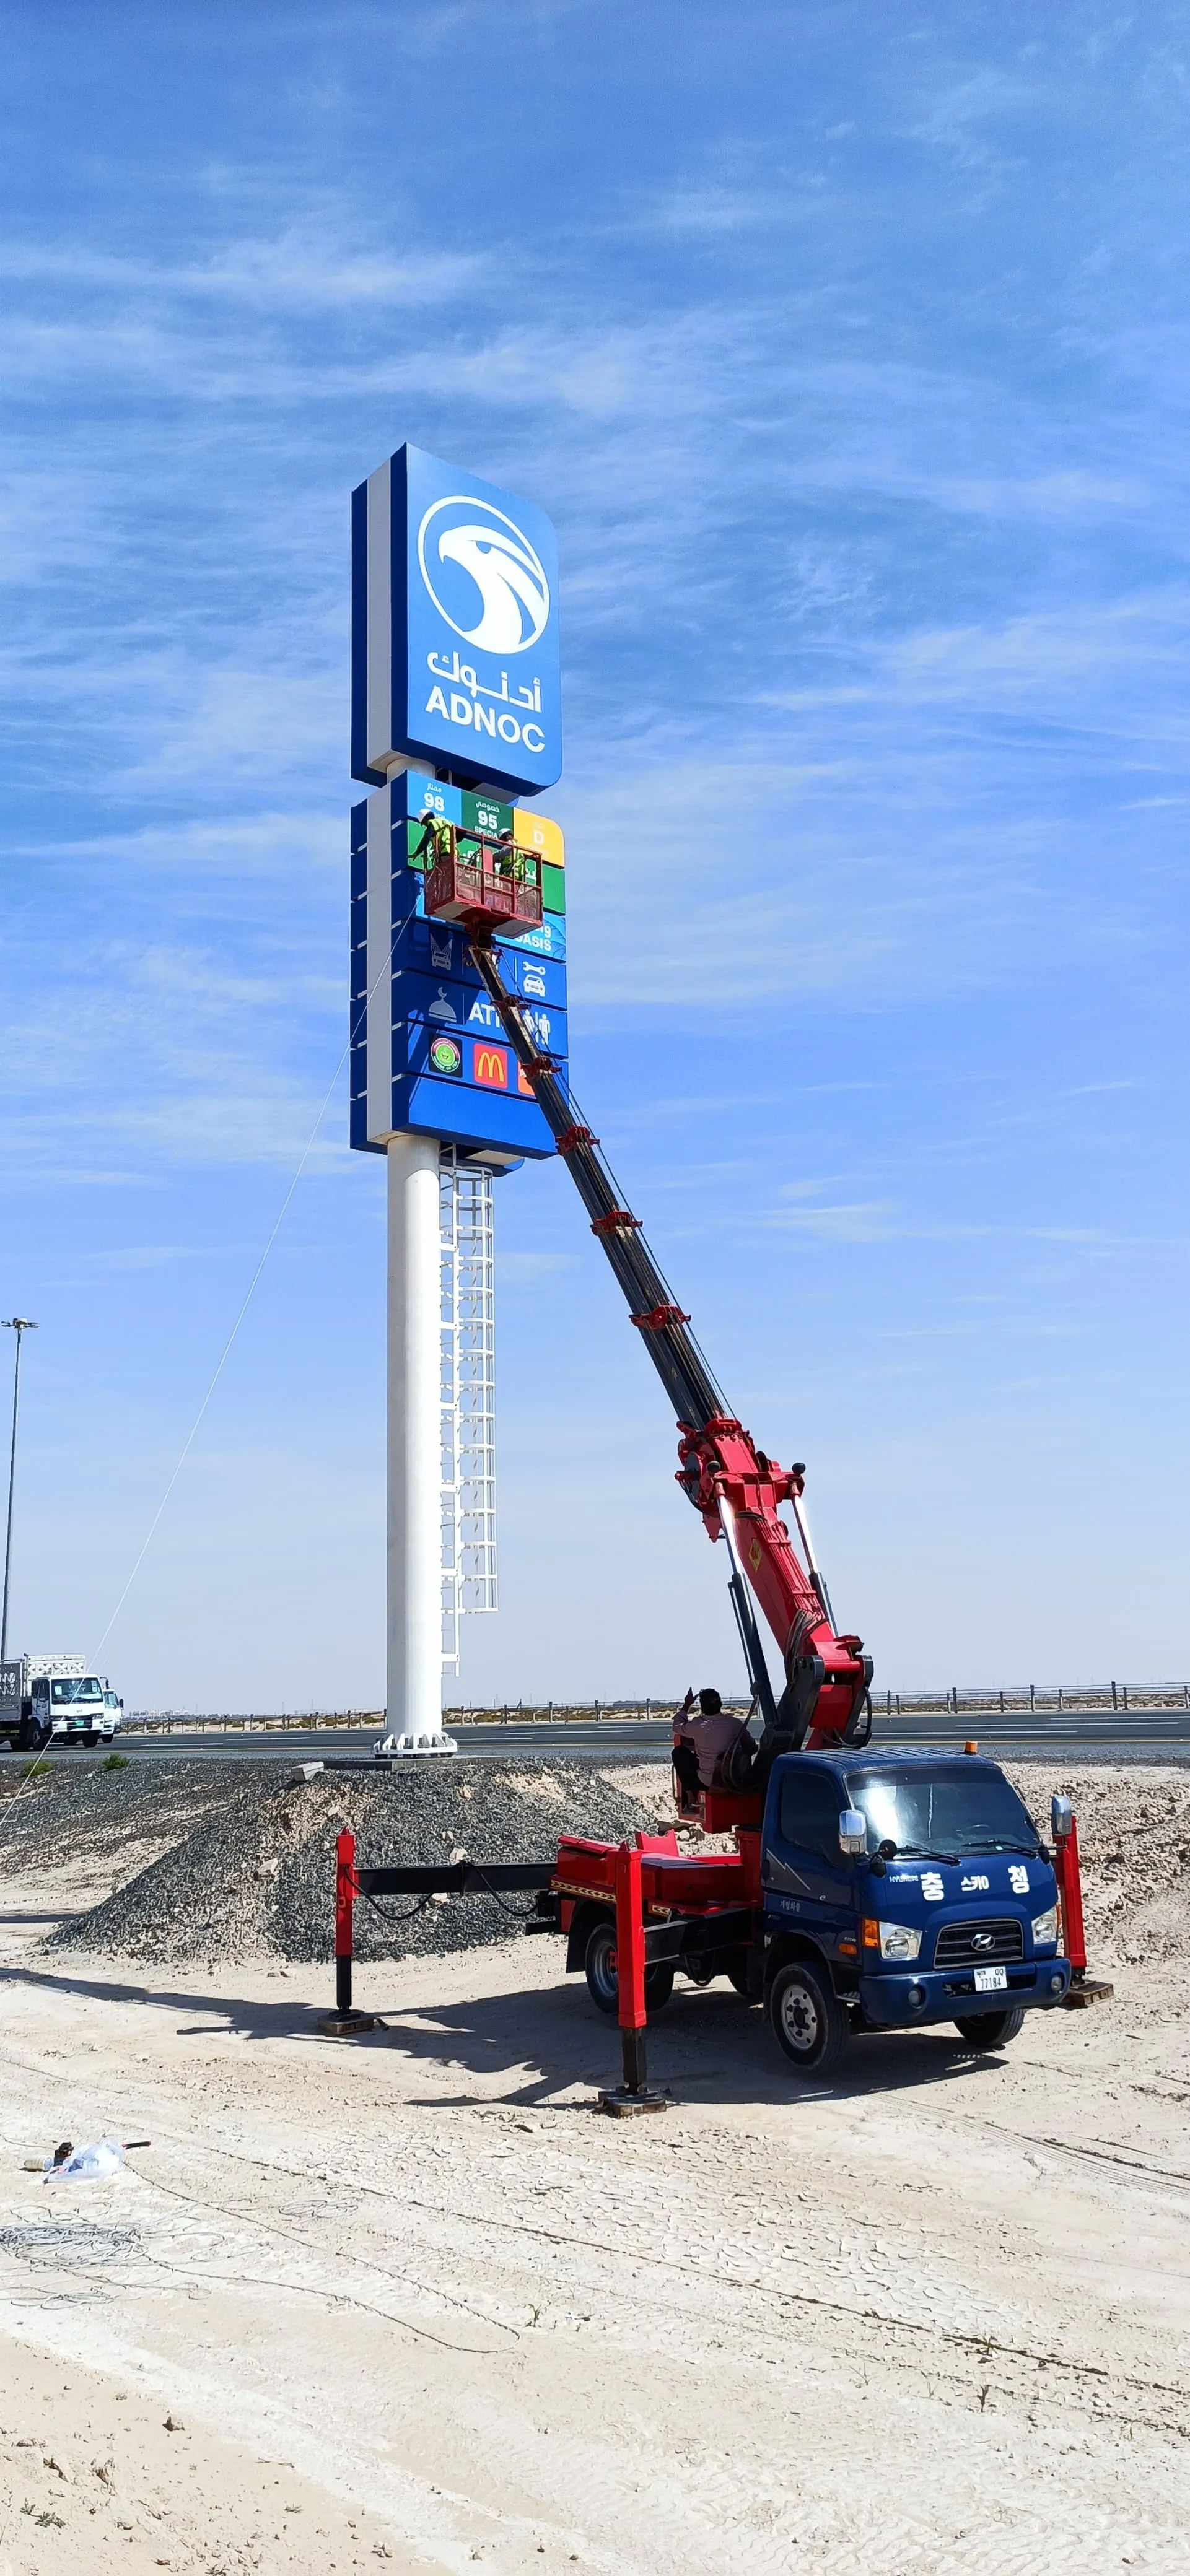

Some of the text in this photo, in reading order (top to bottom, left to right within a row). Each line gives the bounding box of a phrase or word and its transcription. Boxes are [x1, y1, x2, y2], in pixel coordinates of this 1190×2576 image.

[425, 685, 546, 753] ADNOC
[424, 792, 445, 812] 98
[478, 810, 498, 830] 95
[474, 826, 498, 840] SPECIA
[533, 829, 545, 845] D
[920, 1871, 945, 1901] 충
[1008, 1865, 1030, 1894] 청
[981, 1977, 1001, 1990] 77184
